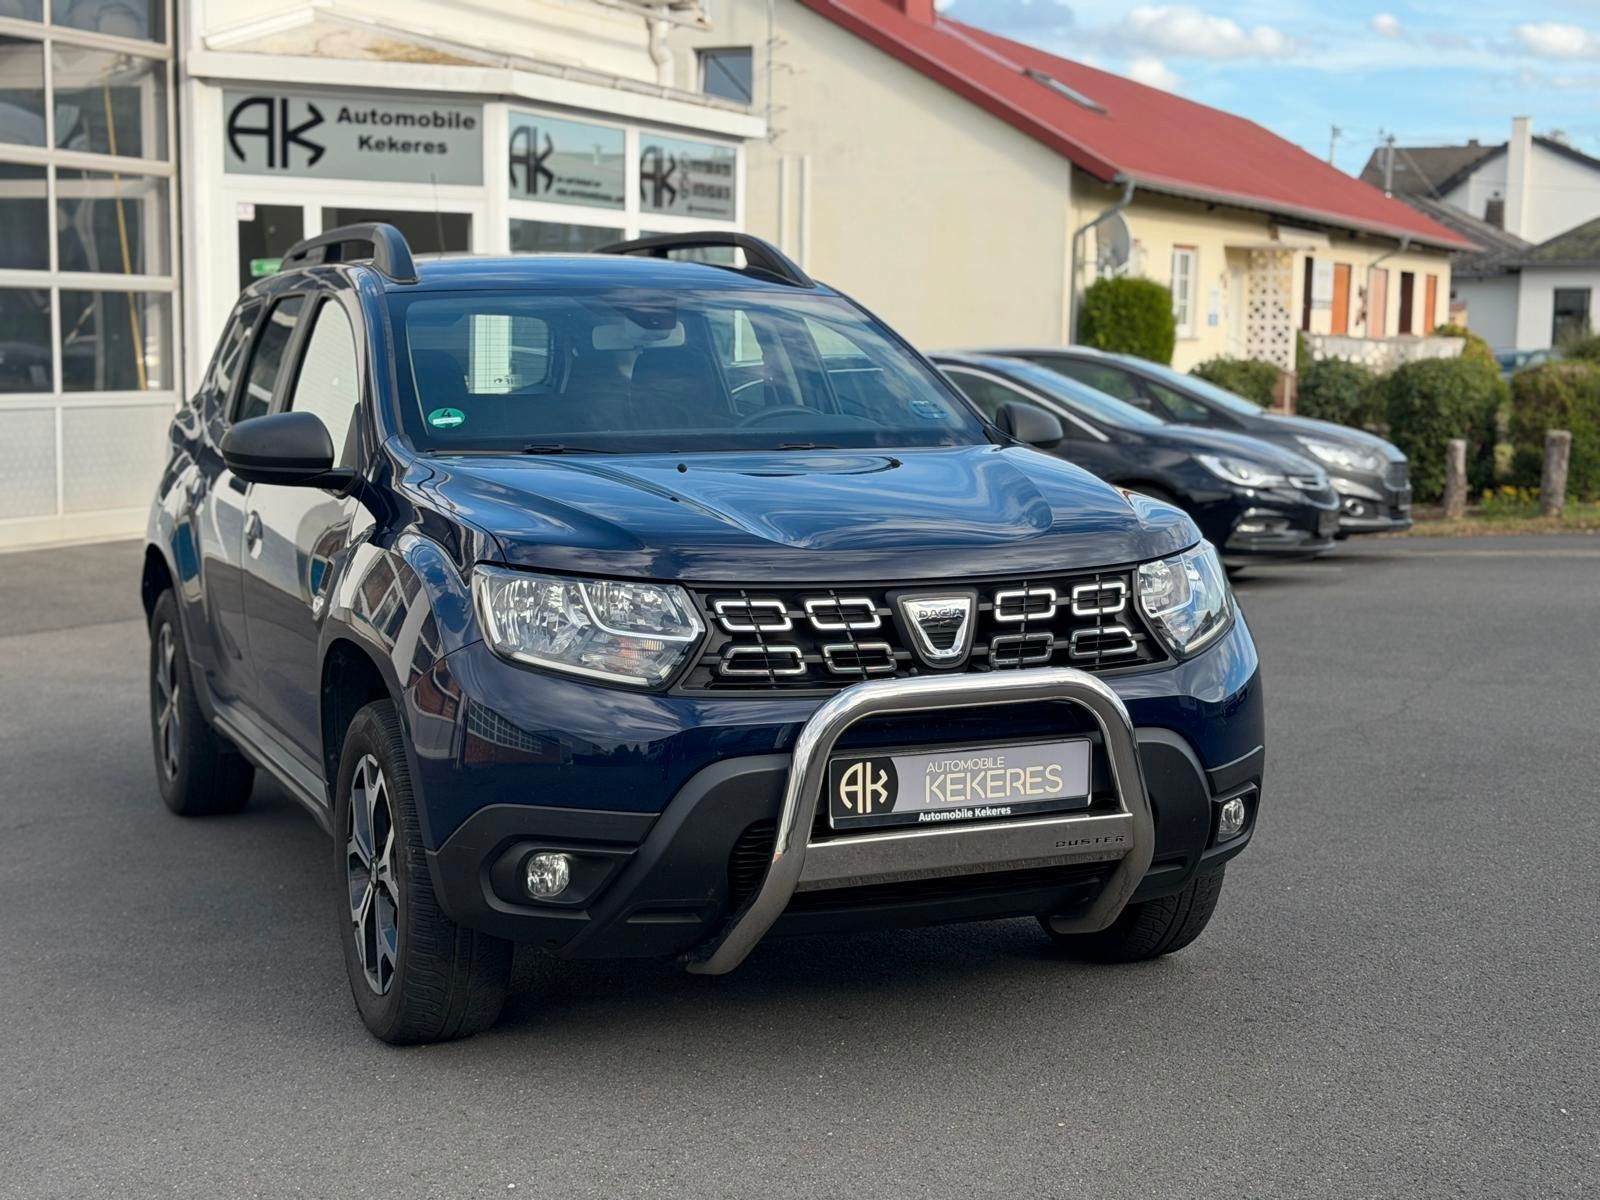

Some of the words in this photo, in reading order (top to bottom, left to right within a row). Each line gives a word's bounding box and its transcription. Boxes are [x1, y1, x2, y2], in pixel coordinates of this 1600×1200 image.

[336, 106, 476, 130] Automobile
[228, 96, 327, 169] AK
[358, 134, 448, 155] Kekeres
[918, 608, 964, 620] DACIA
[926, 756, 1005, 774] AUTOMOBILE
[839, 761, 889, 815] AK
[925, 763, 1064, 804] KEKERES
[918, 807, 973, 823] Automobile
[974, 805, 1012, 818] Kekeres
[1055, 835, 1125, 848] DUSTER
